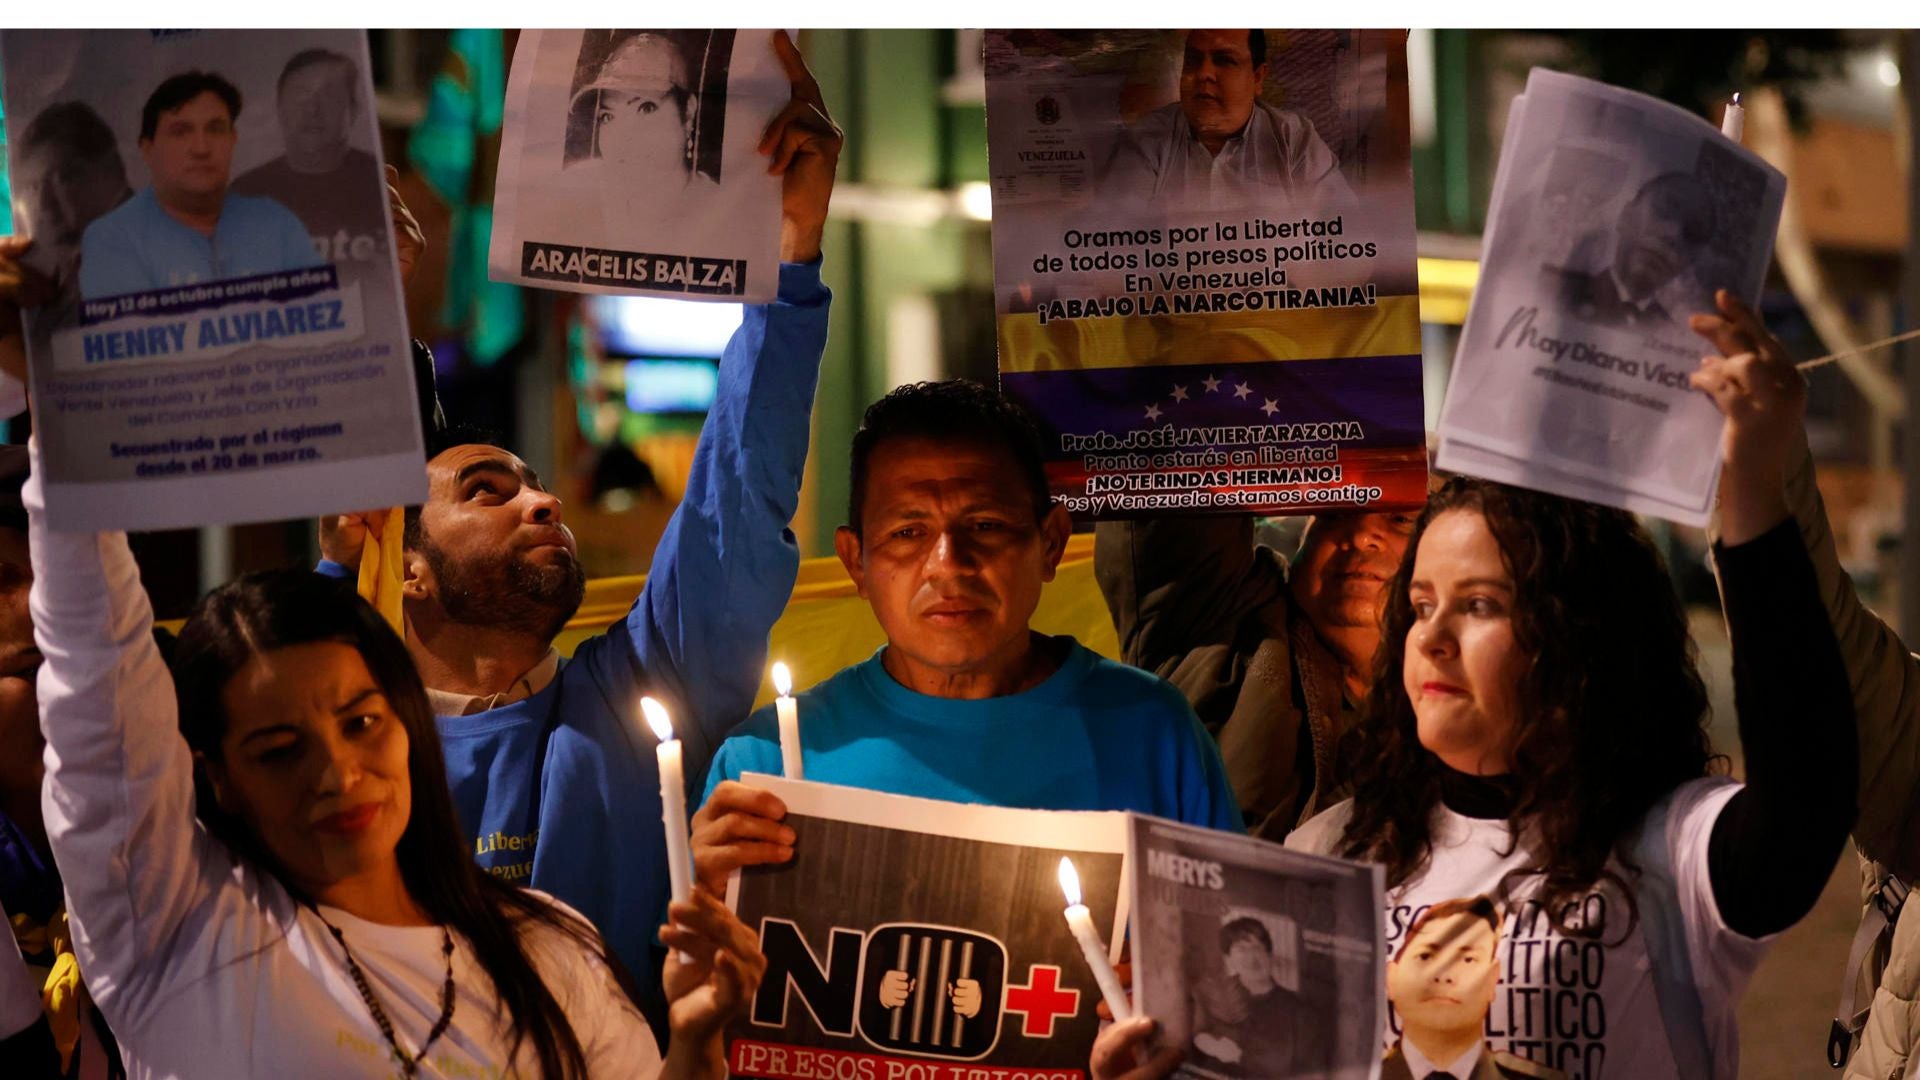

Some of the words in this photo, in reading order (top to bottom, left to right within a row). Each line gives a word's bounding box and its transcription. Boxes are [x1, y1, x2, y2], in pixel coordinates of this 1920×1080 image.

[1018, 150, 1086, 163] VENEZUELA
[1064, 229, 1162, 248] Oramos
[1168, 226, 1209, 250] por
[1215, 222, 1238, 242] la
[1244, 215, 1343, 240] Libertad
[530, 249, 648, 283] ARACELIS
[654, 260, 737, 289] BALZA
[1033, 254, 1063, 273] de
[1069, 251, 1138, 272] todos
[1145, 249, 1179, 268] los
[1186, 247, 1267, 273] presos
[1274, 239, 1377, 268] políticos
[85, 303, 117, 318] Hoy
[137, 295, 157, 310] de
[160, 285, 224, 307] octubre
[226, 275, 288, 296] cumple
[290, 271, 331, 287] años
[1125, 273, 1153, 292] En
[1159, 267, 1286, 291] Venezuela
[1039, 297, 1134, 325] ¡ABAJO
[1138, 295, 1169, 315] LA
[1174, 285, 1377, 313] NARCOTIRANIA!
[83, 322, 188, 365] HENRY
[198, 299, 346, 350] ALVIAREZ
[1495, 306, 1569, 362] May
[1569, 342, 1639, 377] Diana
[110, 436, 215, 458] Secuestrado
[219, 433, 247, 452] por
[253, 427, 268, 446] el
[273, 421, 343, 444] régimen
[1062, 431, 1123, 450] Profe.
[1123, 424, 1174, 447] JOSÉ
[1176, 426, 1249, 447] JAVIER
[1250, 421, 1364, 443] TARAZONA
[136, 458, 187, 477] desde
[191, 456, 206, 472] el
[212, 453, 233, 471] 20
[237, 452, 258, 468] de
[263, 447, 323, 466] marzo.
[1084, 453, 1149, 471] Pronto
[1153, 448, 1227, 468] estarás
[1231, 450, 1257, 465] en
[1260, 444, 1338, 465] libertad
[1086, 474, 1125, 495] ¡NO
[1127, 474, 1152, 491] TE
[1153, 471, 1230, 490] RINDAS
[1231, 465, 1342, 487] HERMANO!
[1092, 497, 1106, 515] y
[1107, 491, 1211, 510] Venezuela
[1214, 490, 1302, 505] estamos
[1304, 484, 1382, 505] contigo
[1147, 848, 1225, 890] MERYS
